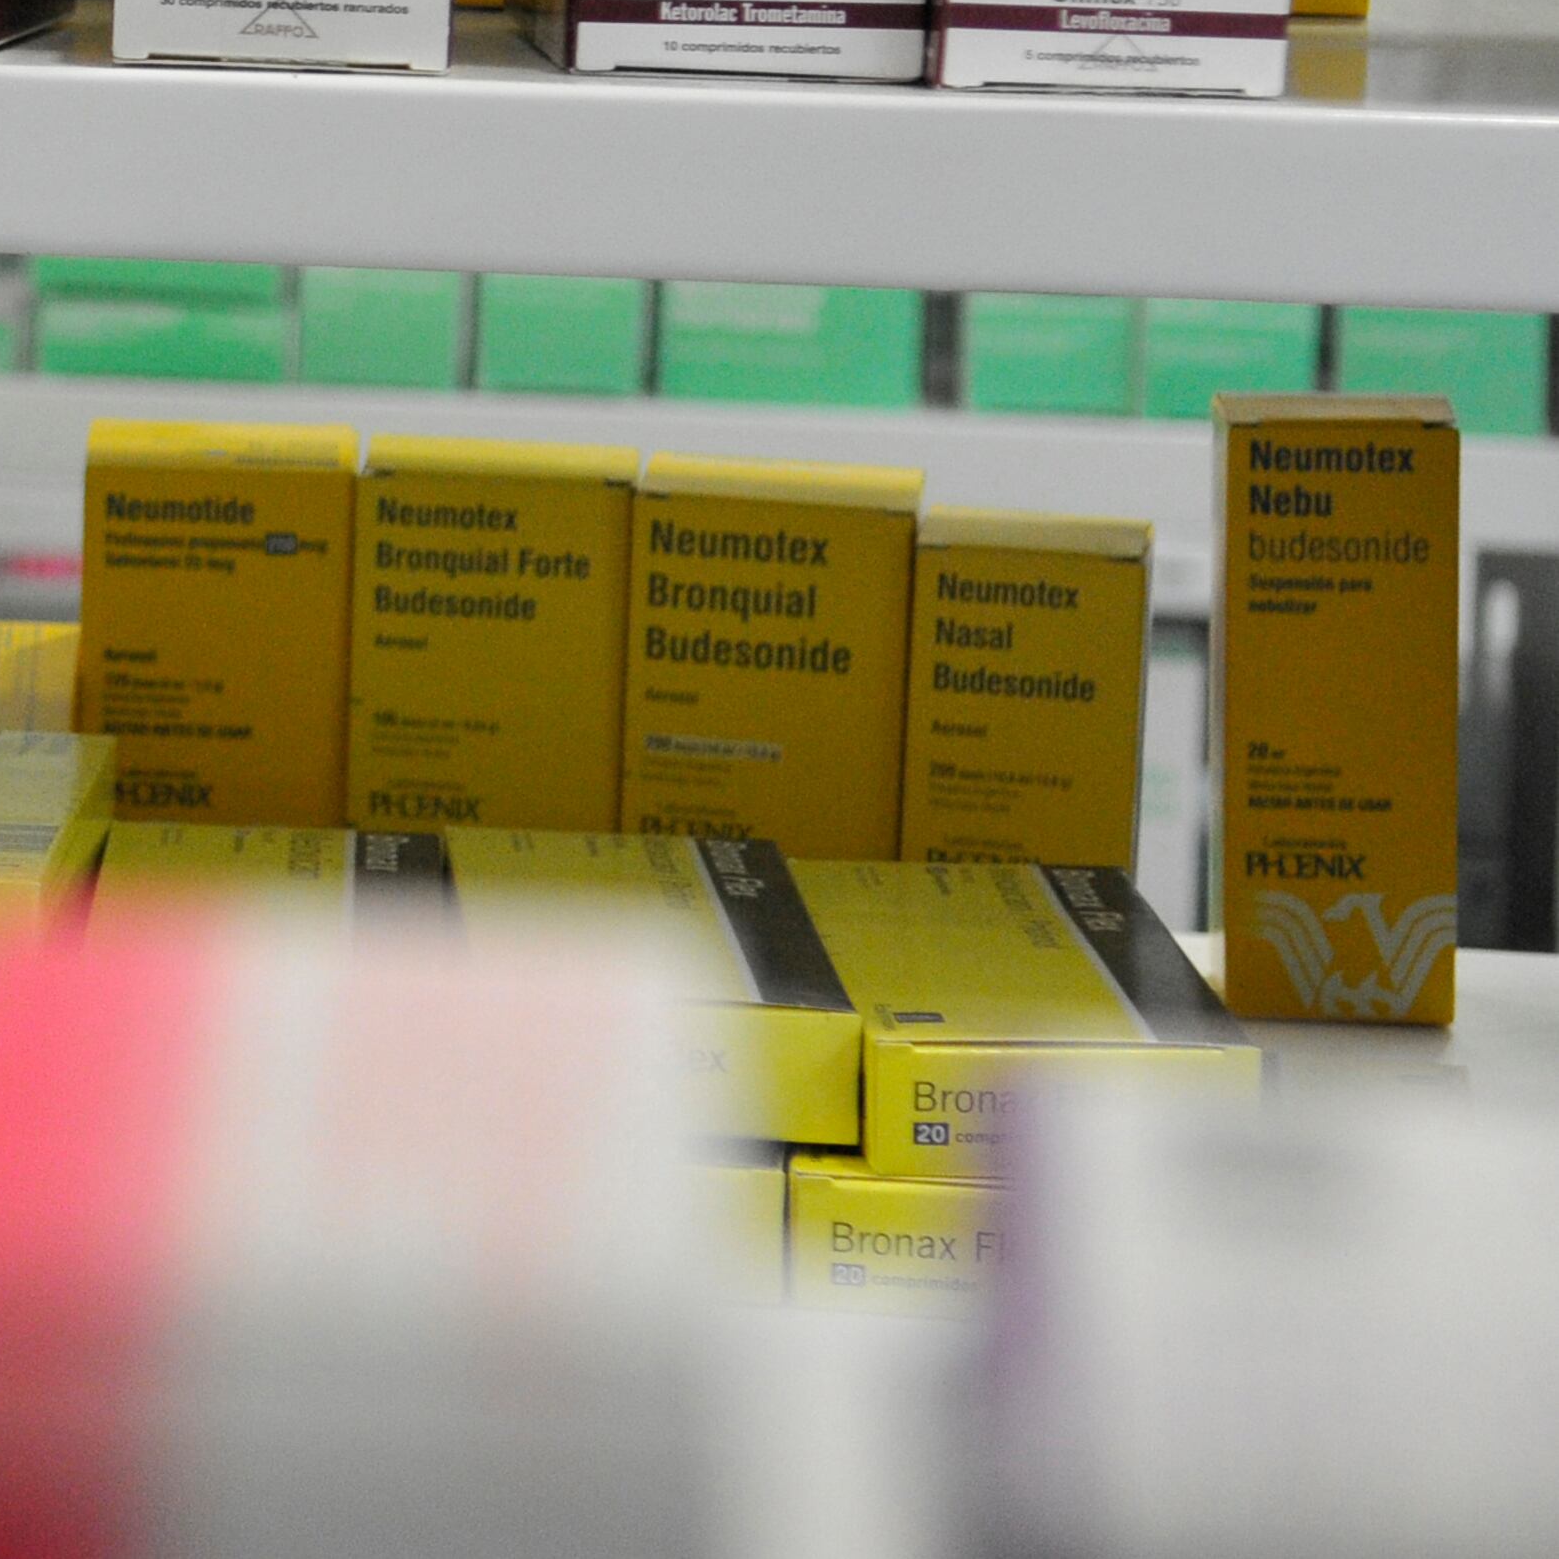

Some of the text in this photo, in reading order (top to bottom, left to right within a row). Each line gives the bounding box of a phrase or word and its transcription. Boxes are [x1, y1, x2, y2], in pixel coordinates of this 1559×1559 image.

[343, 2, 409, 15] ranurados
[1249, 439, 1415, 475] Neumotex
[106, 492, 256, 525] Neumotide
[378, 496, 518, 532] Neumotex
[1249, 483, 1333, 519] Nebu
[376, 541, 591, 581] Bronquial Forte
[650, 519, 829, 567] Neumotex
[1249, 530, 1430, 564] budesonide
[375, 585, 537, 622] Budesonide
[647, 572, 817, 623] Bronquial
[937, 572, 1080, 611] Neumotex
[645, 625, 852, 676] Budesonide
[935, 618, 1014, 651] Nasal
[932, 663, 1096, 703] Budesonide
[918, 1126, 946, 1142] 20
[831, 1221, 957, 1262] Bronax
